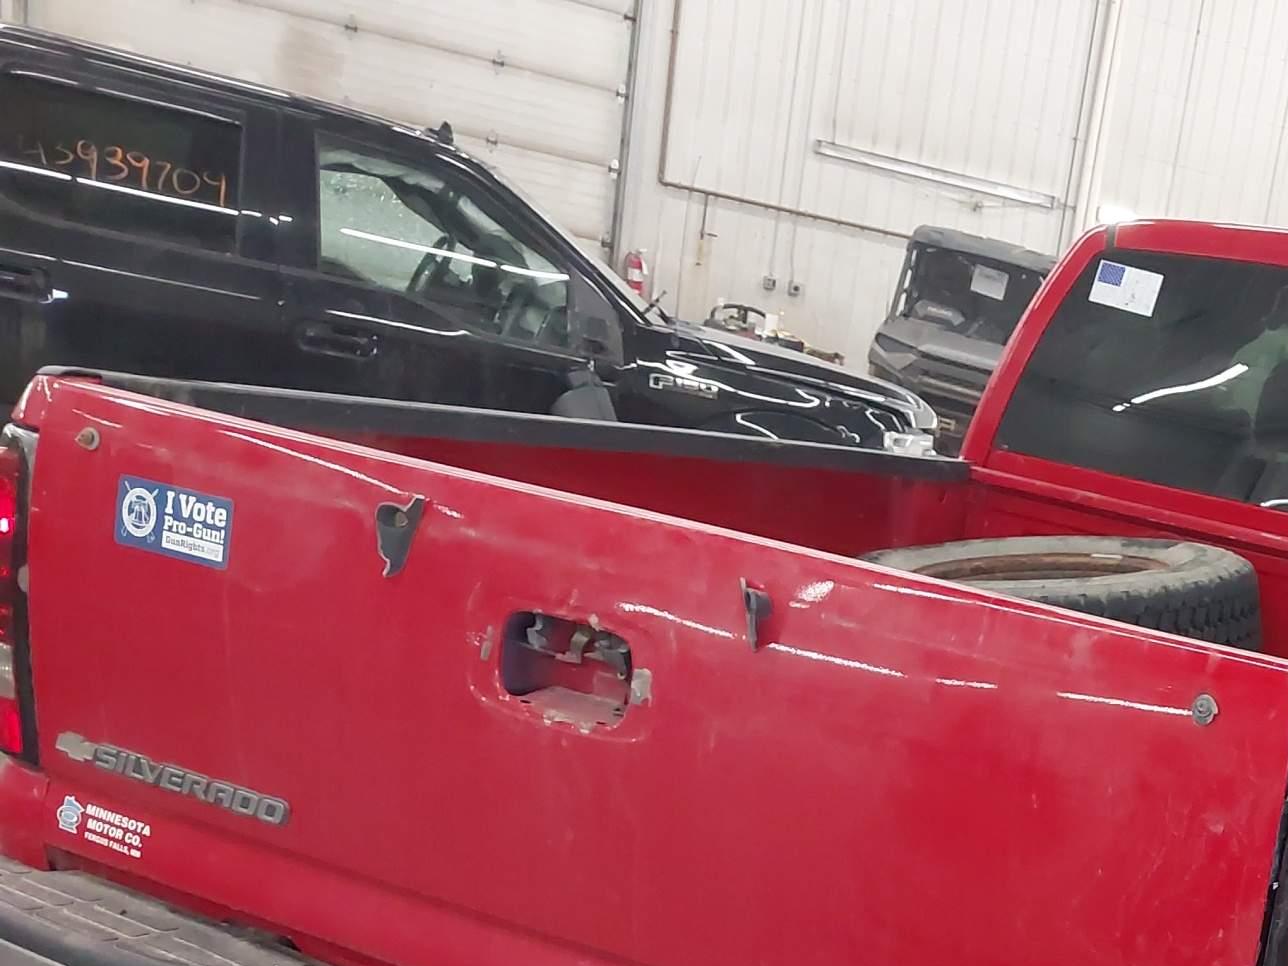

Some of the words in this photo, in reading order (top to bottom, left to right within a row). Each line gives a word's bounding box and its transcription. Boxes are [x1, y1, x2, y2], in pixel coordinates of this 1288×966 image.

[165, 490, 175, 514] I
[179, 494, 227, 527] Vote
[163, 515, 225, 544] Pro-Gun!
[94, 744, 291, 826] SILVERADO
[86, 804, 151, 836] MINNESOTA
[87, 818, 124, 840] MOTOR
[125, 833, 142, 847] CO.
